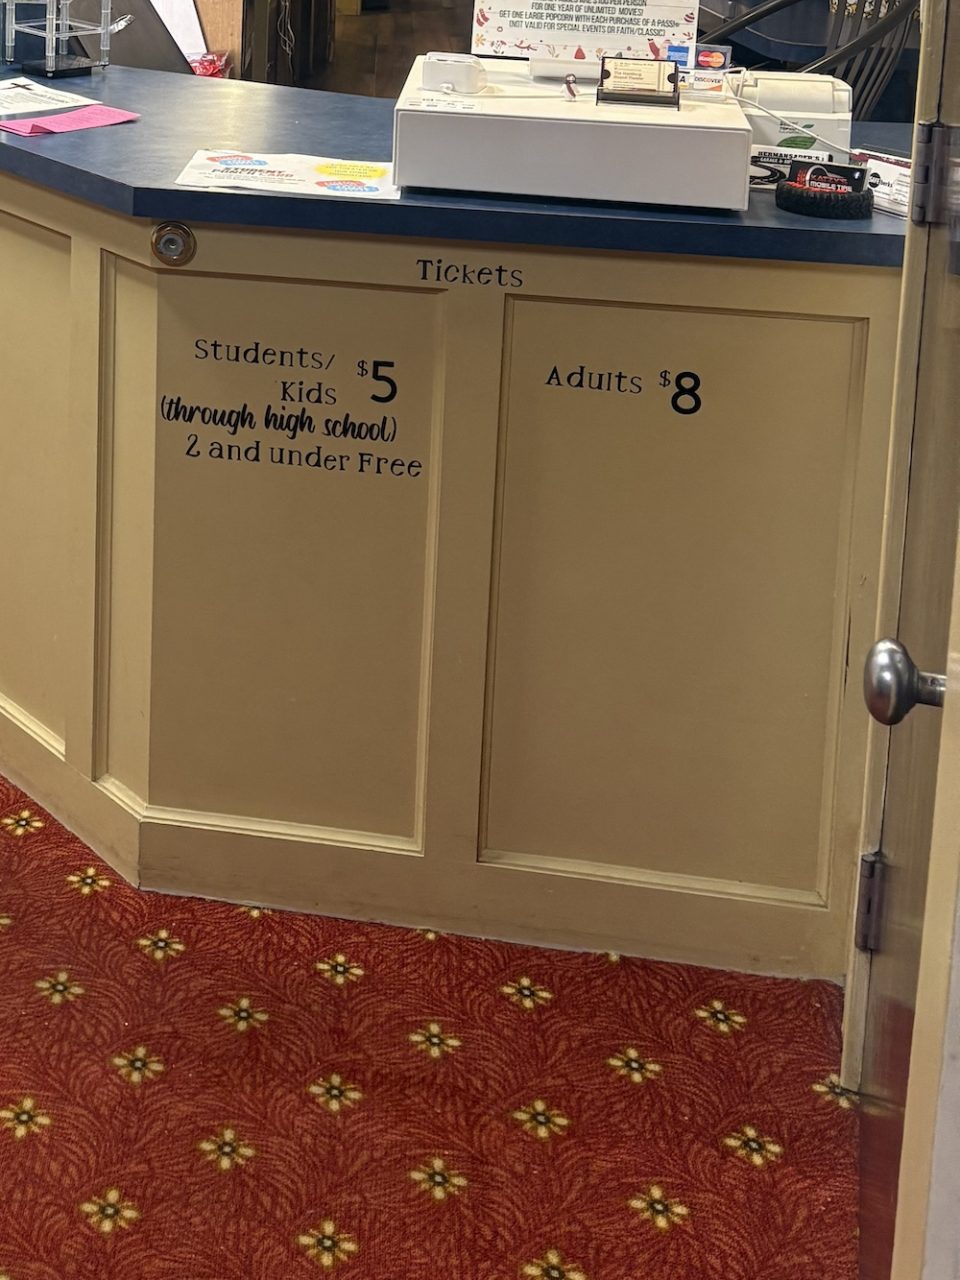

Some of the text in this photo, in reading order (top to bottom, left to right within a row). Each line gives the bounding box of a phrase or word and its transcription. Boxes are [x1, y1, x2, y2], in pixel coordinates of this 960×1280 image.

[499, 10, 510, 18] GET
[512, 11, 524, 19] ONE
[525, 11, 544, 20] LARGE
[546, 13, 574, 21] POPCORN
[575, 14, 590, 22] WITH
[609, 17, 640, 25] PURCHASE
[531, 2, 543, 10] FOR
[544, 3, 556, 11] ONE
[558, 4, 573, 12] YEAR
[575, 4, 583, 13] OF
[584, 6, 616, 15] UNLIMITED
[525, 21, 543, 29] VALID
[543, 22, 555, 30] FOR
[556, 23, 581, 32] SPECIAL
[582, 24, 606, 33] EVENTS
[694, 76, 722, 84] DISCOVER
[417, 259, 523, 287] Tickets
[194, 339, 336, 370] Students/
[280, 381, 337, 405] Kids
[357, 360, 397, 403] $5
[545, 366, 642, 394] Adults
[659, 370, 702, 415] $8
[161, 395, 397, 442] (through high school)
[186, 434, 423, 478] 2 and under Free
